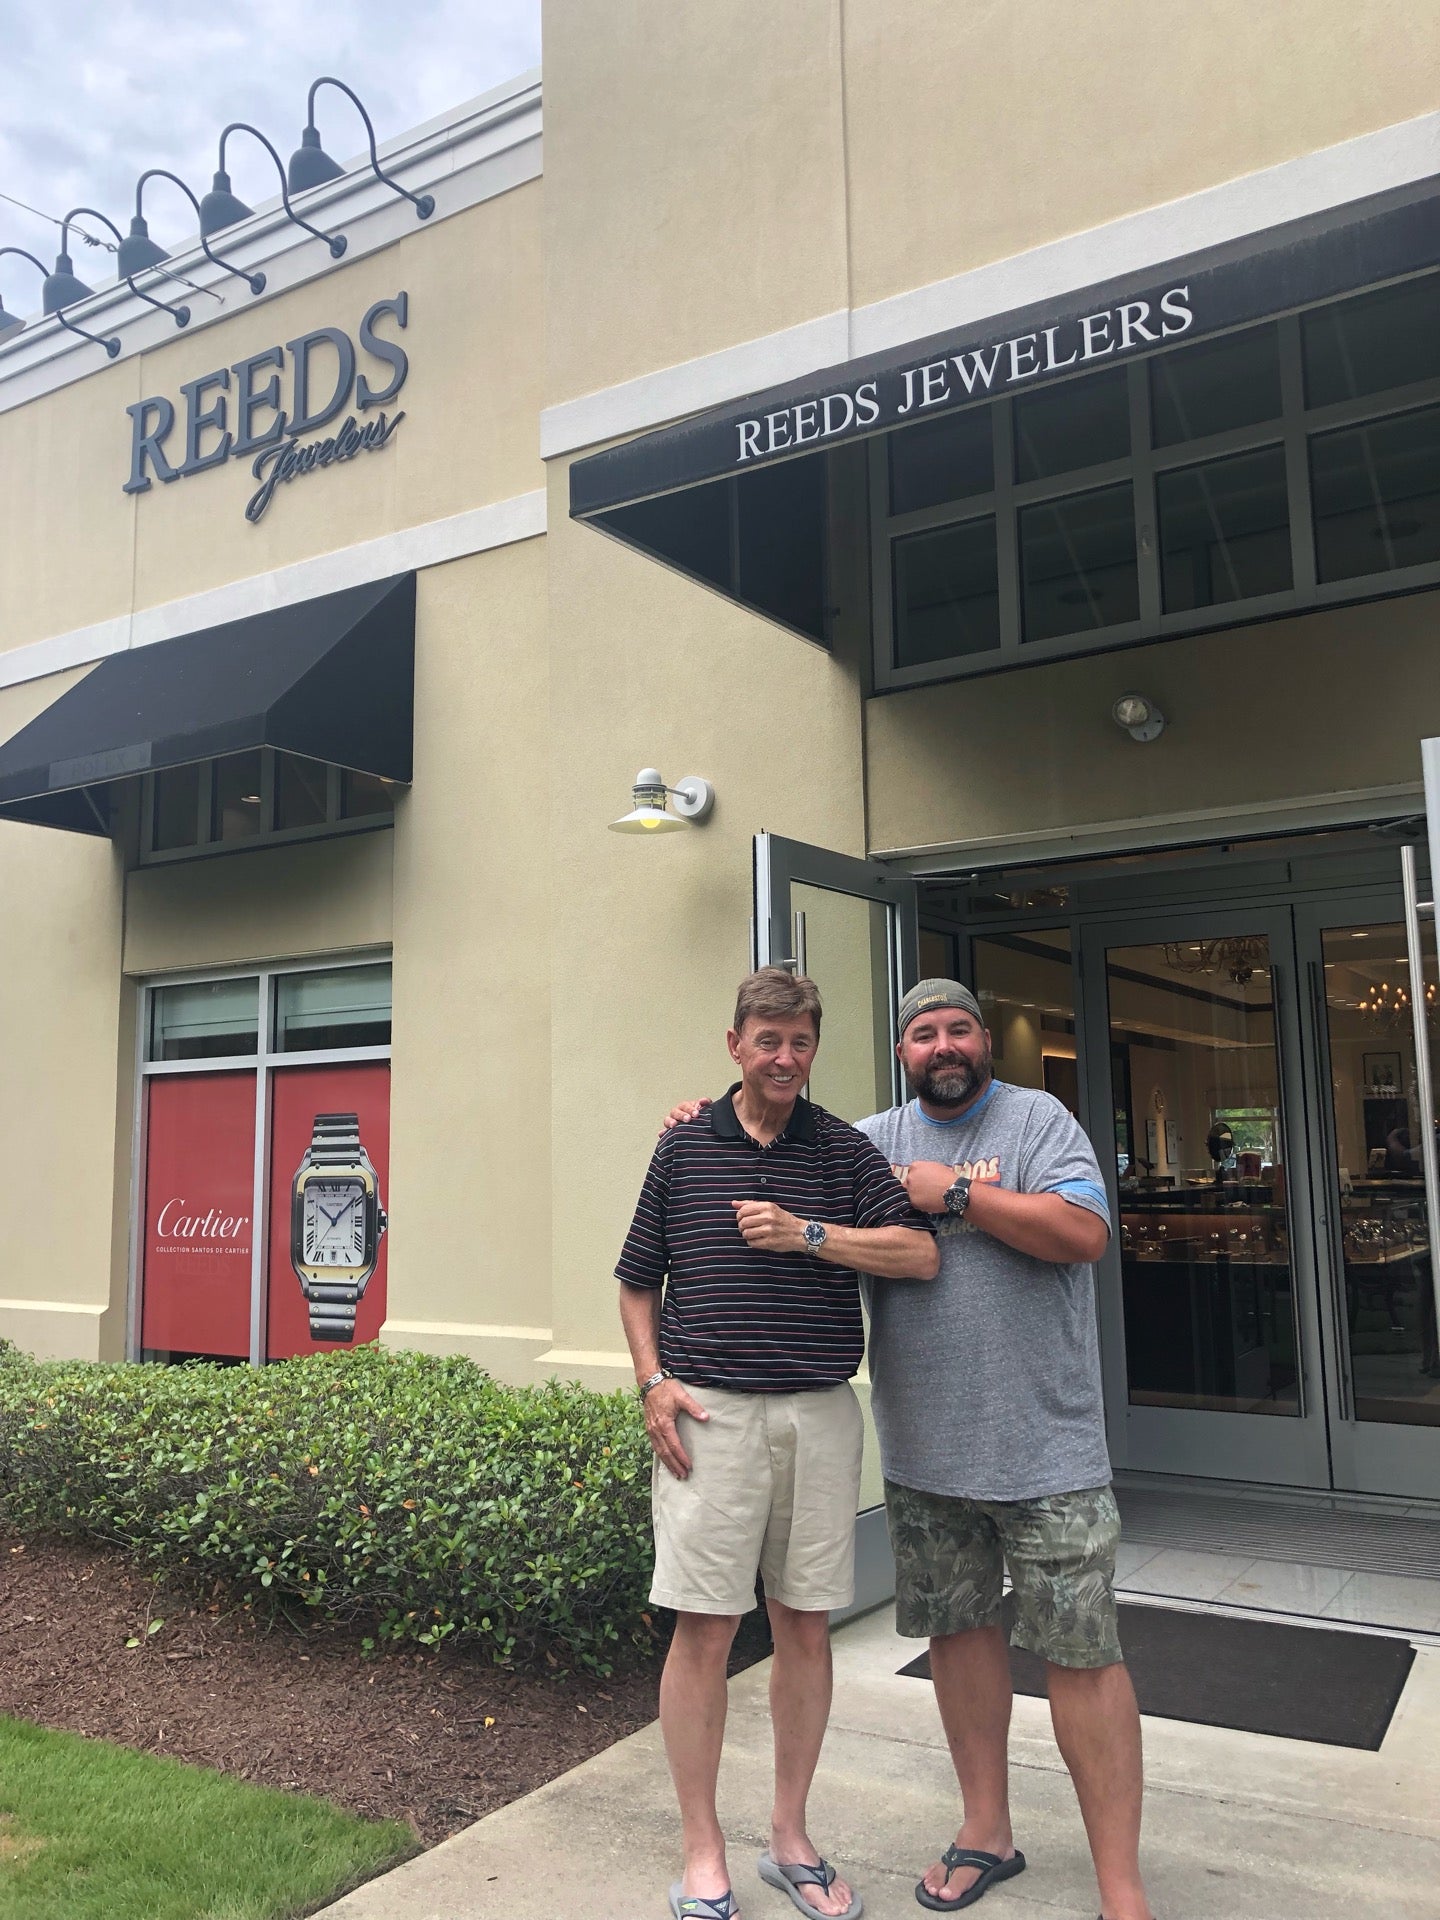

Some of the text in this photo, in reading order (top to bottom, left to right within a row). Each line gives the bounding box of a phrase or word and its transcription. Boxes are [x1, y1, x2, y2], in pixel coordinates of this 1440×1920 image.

[122, 290, 409, 495] REEDS
[735, 285, 1194, 463] REEDS JEWELERS
[245, 410, 406, 523] Jewelers
[157, 1197, 249, 1238] Cartier
[191, 1246, 214, 1254] SANTOS
